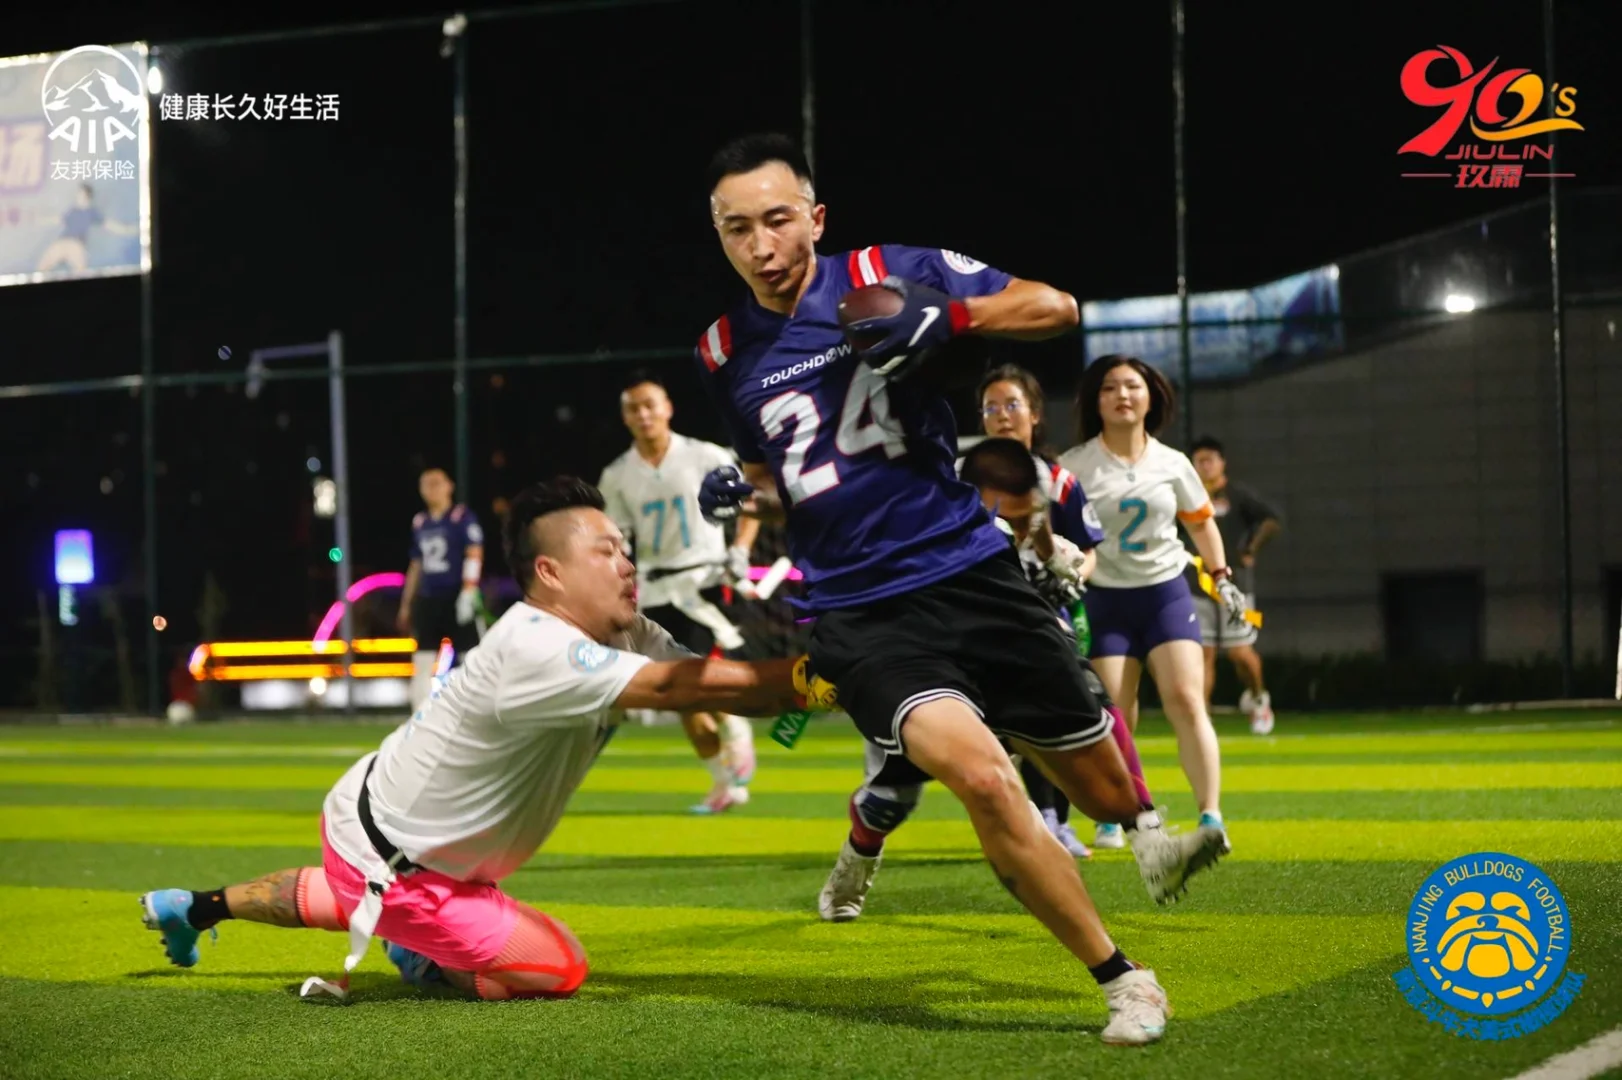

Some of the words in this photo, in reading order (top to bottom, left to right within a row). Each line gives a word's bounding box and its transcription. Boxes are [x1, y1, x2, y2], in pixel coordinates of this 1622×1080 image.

[760, 360, 909, 506] 24
[641, 496, 692, 555] 71
[1118, 498, 1149, 552] 2
[419, 535, 451, 574] 12
